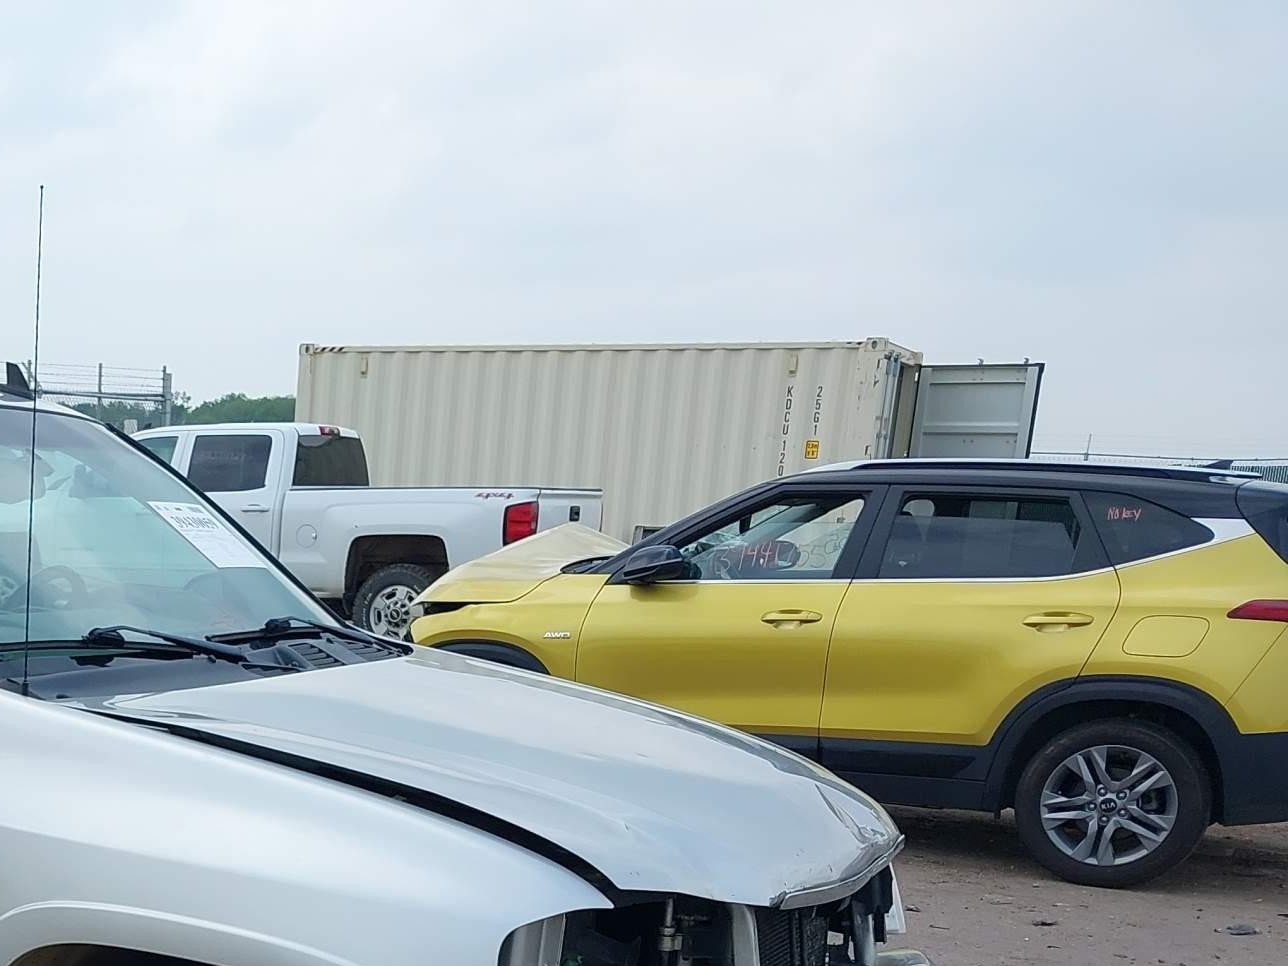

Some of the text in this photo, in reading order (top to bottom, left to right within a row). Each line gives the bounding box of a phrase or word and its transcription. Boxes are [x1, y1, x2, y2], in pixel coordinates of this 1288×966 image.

[782, 385, 794, 436] KDCU
[543, 631, 571, 639] AWD
[1101, 801, 1116, 810] KIA
